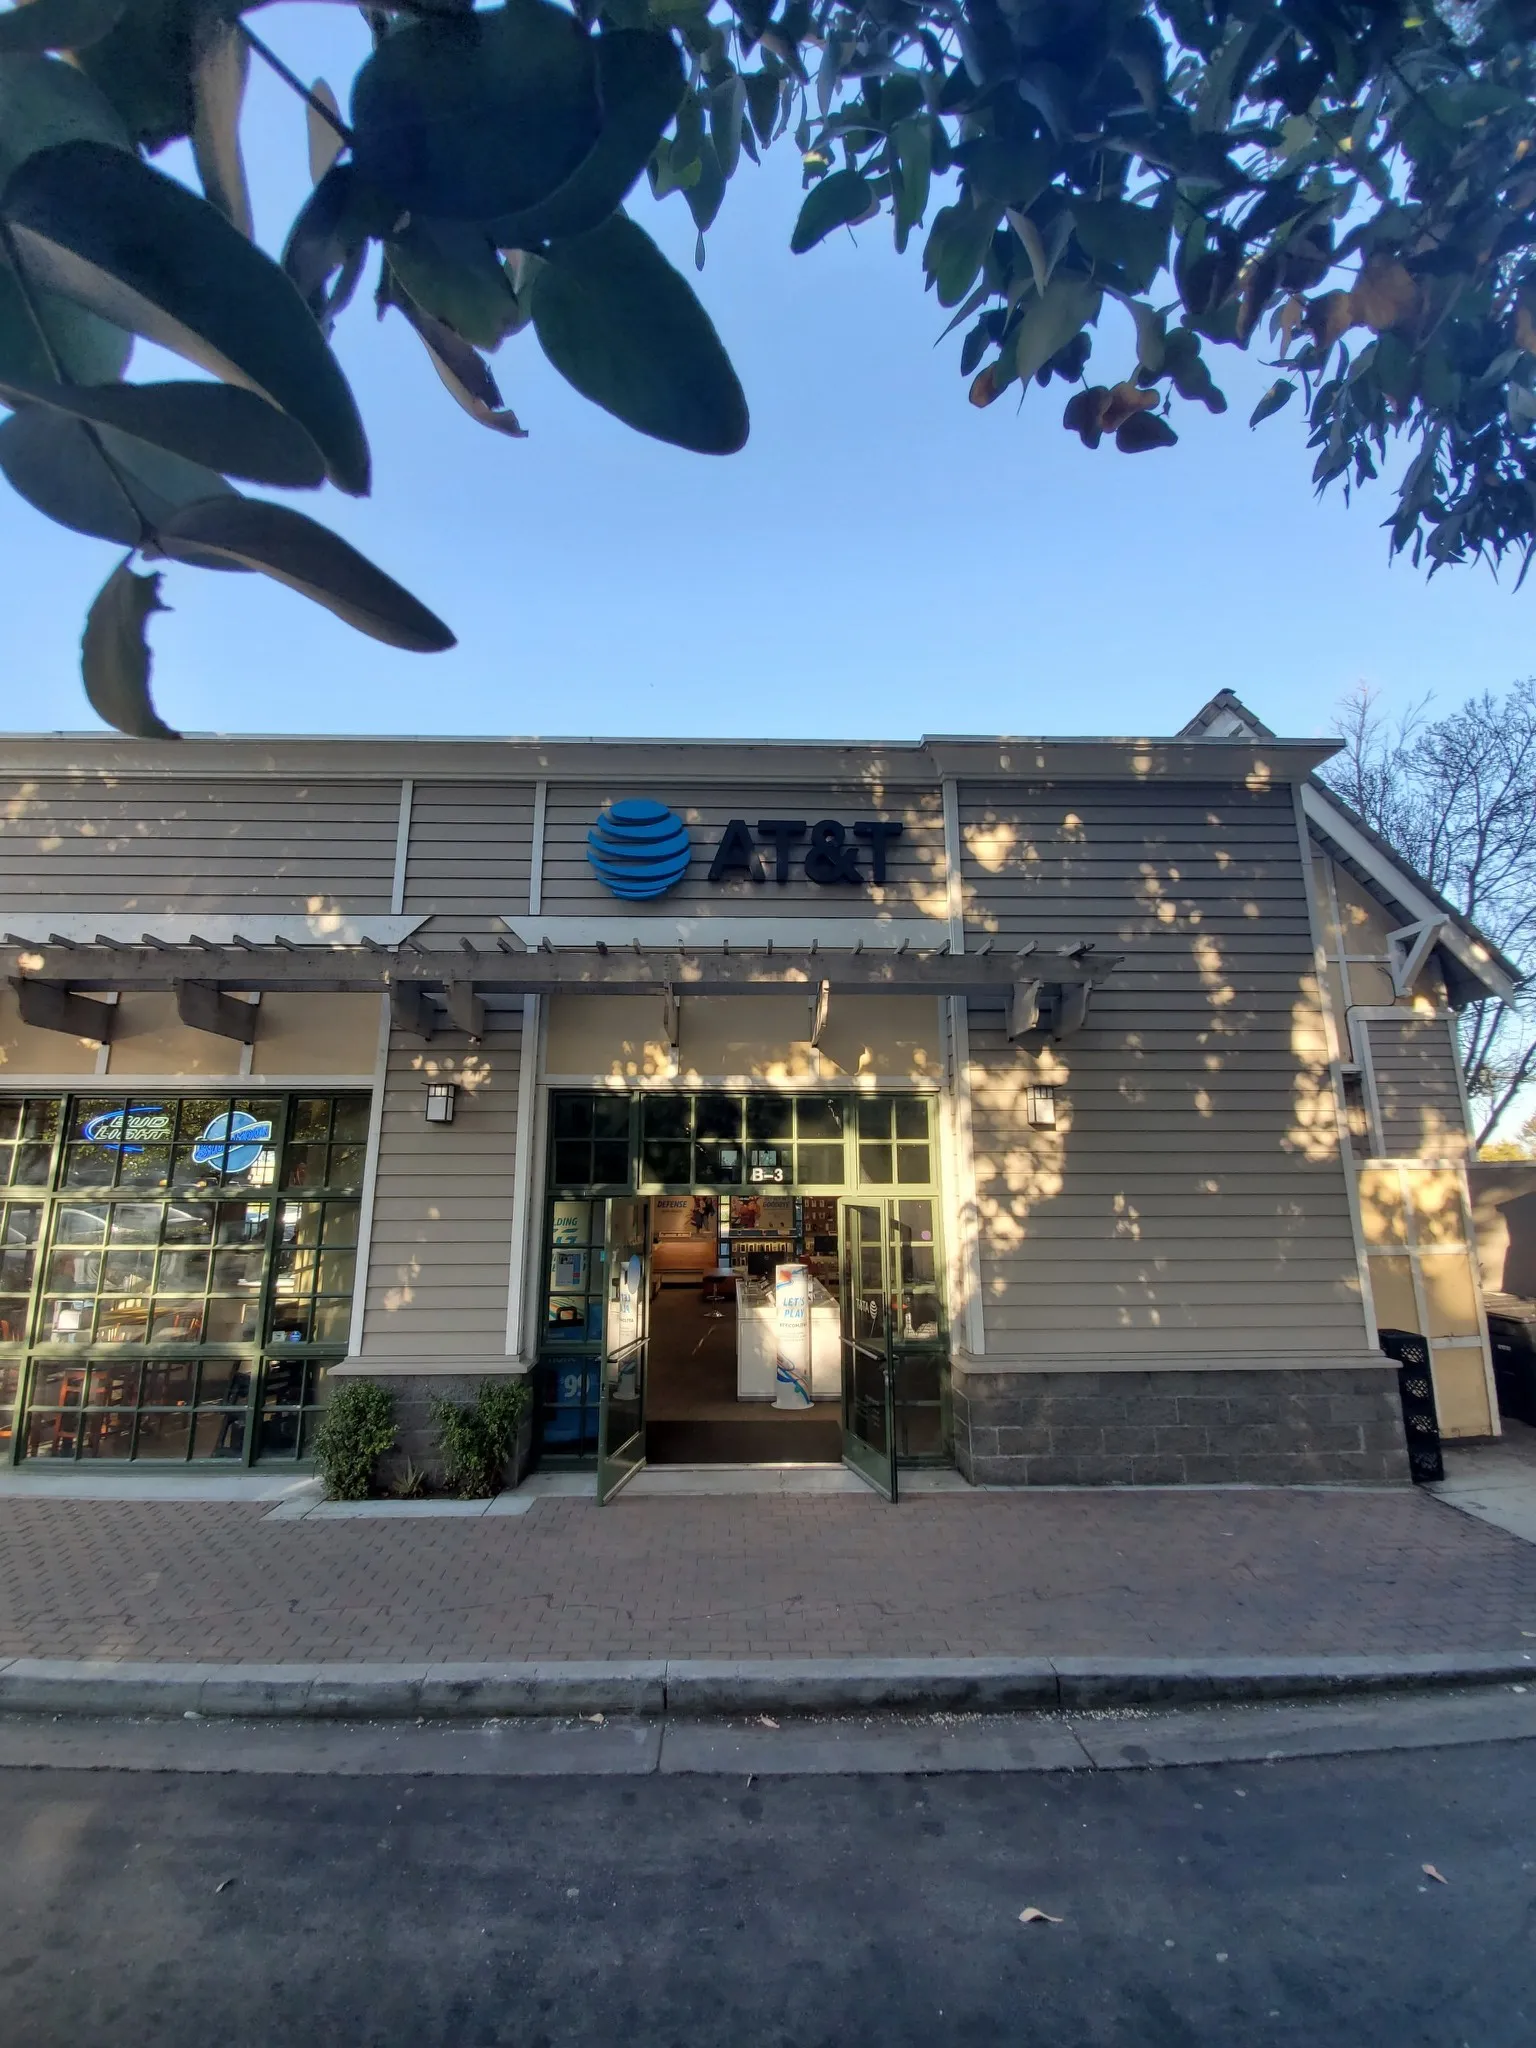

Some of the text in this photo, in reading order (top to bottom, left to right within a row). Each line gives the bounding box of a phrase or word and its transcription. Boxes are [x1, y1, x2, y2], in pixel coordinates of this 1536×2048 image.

[708, 819, 903, 884] AT&T
[110, 1116, 169, 1128] BUD
[93, 1126, 170, 1140] LIGHT
[196, 1141, 231, 1160] BLU
[657, 1200, 687, 1208] DEFENSE
[783, 1297, 805, 1307] LET'S
[784, 1309, 805, 1318] PLAY
